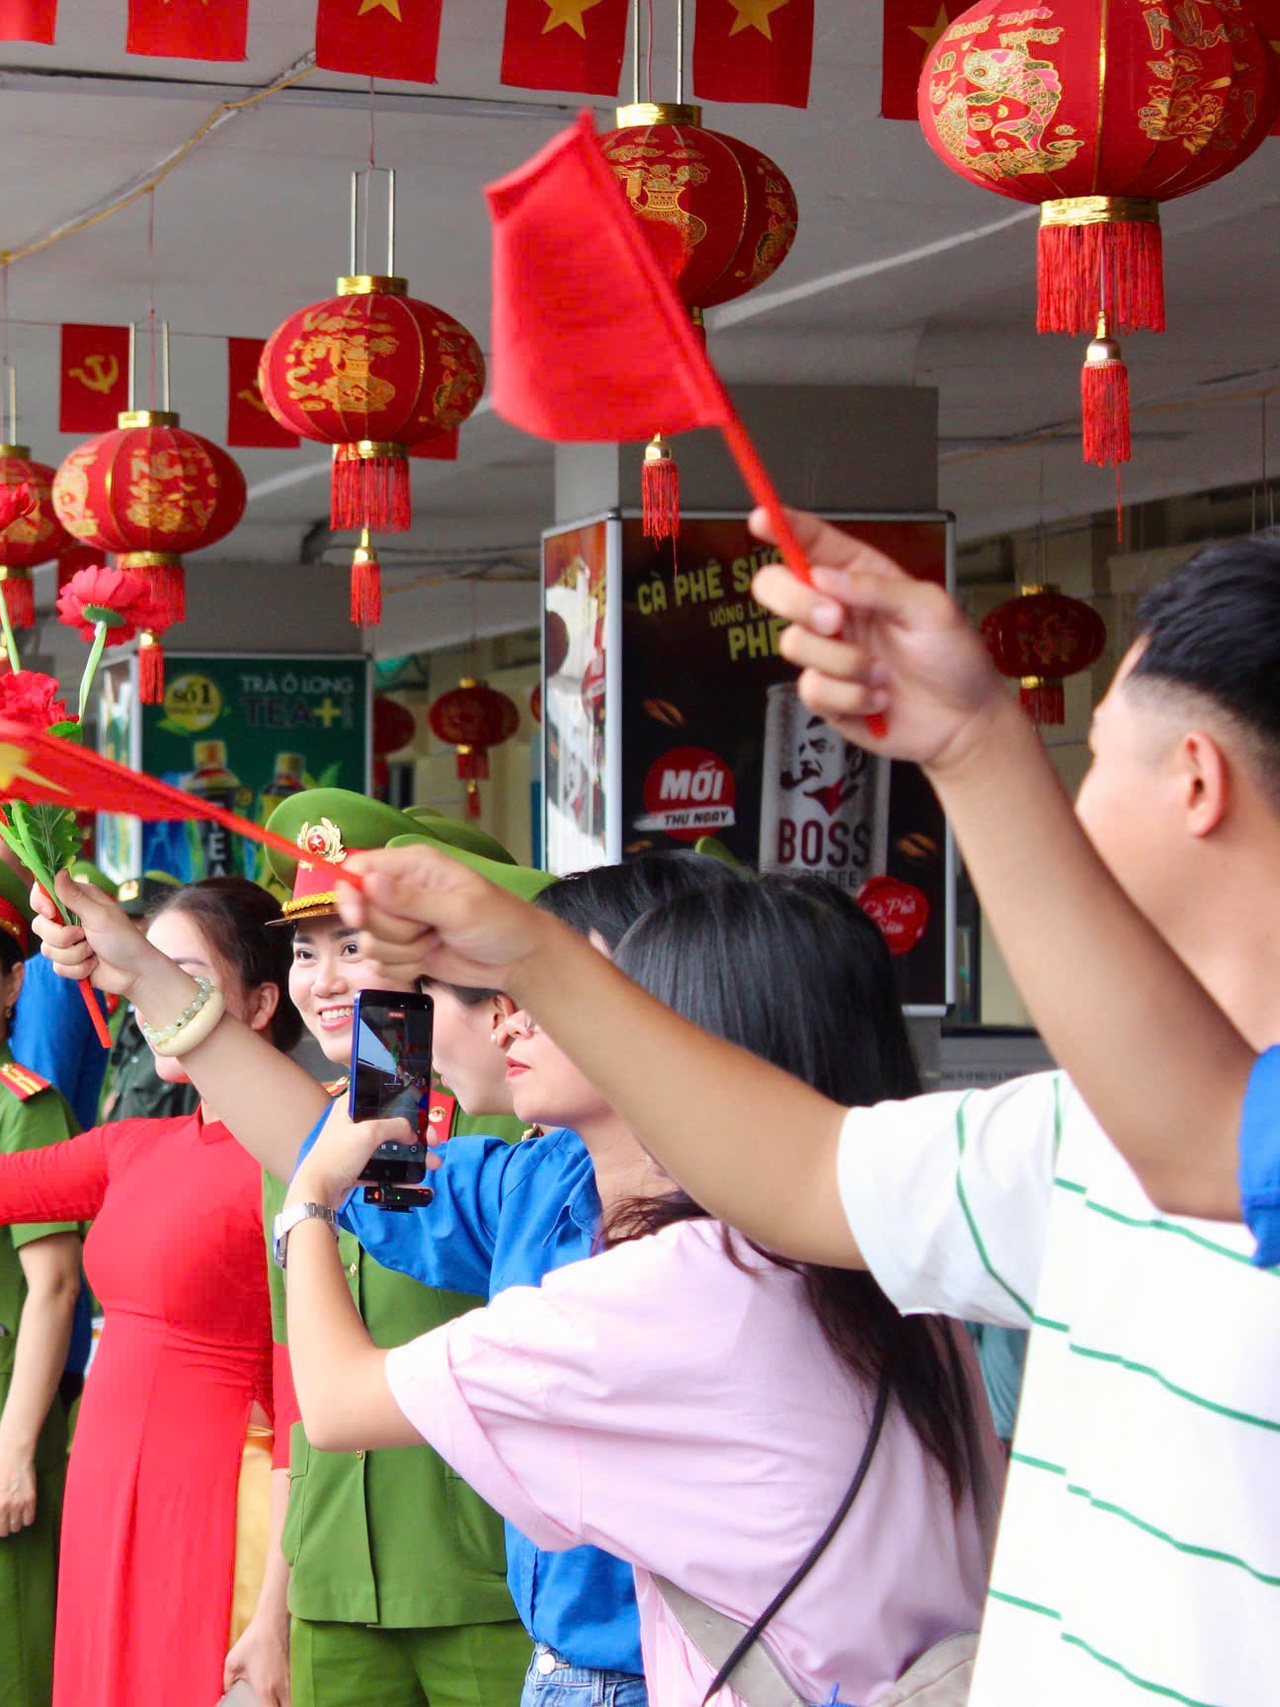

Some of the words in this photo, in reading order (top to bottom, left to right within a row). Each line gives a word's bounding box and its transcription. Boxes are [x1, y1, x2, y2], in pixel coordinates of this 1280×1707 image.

[637, 571, 668, 615] CÀ
[675, 558, 724, 606] PHÊ
[302, 677, 355, 693] LONG
[660, 760, 724, 800] MỚI
[777, 817, 873, 868] BOSS
